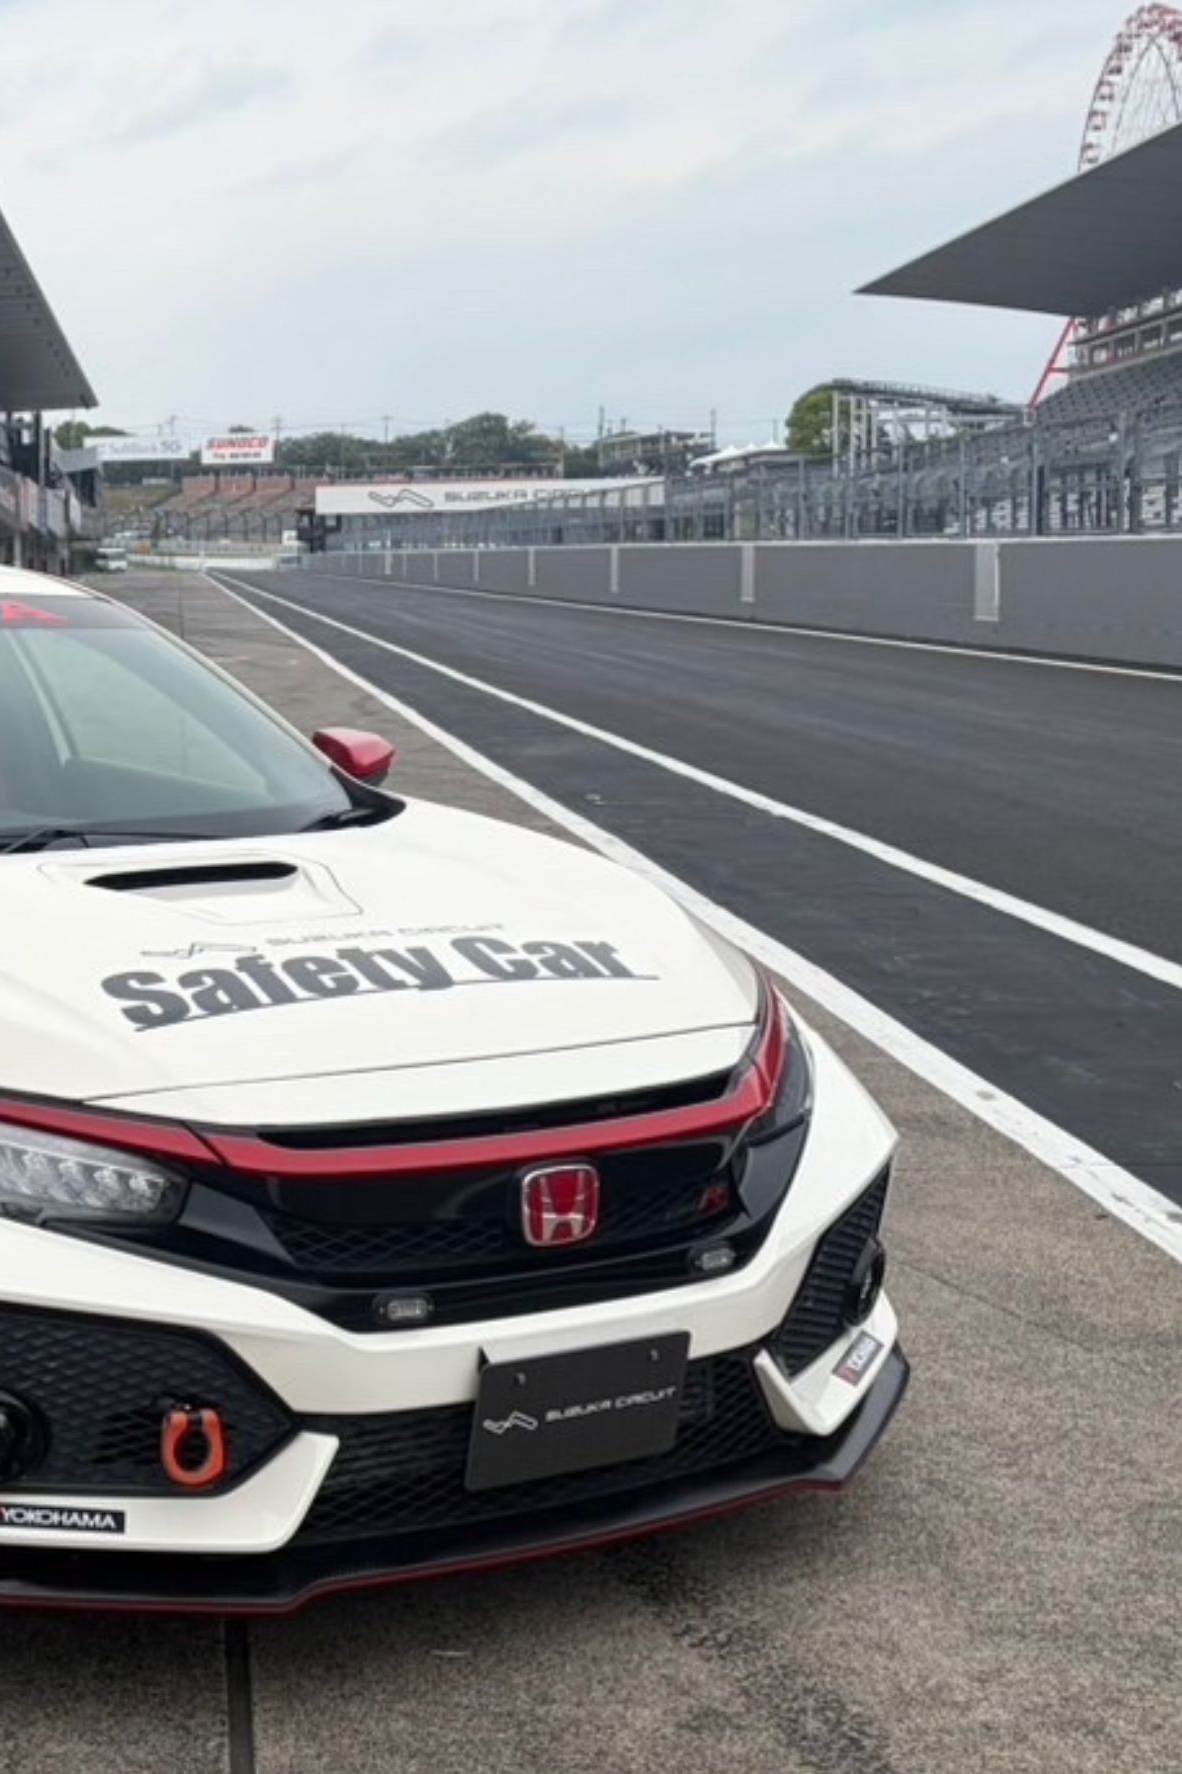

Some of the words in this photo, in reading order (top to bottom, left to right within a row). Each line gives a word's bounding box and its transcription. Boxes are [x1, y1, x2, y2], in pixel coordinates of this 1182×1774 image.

[101, 944, 455, 1028] Safety
[449, 935, 636, 980] Car
[614, 1385, 677, 1409] CIRCUIT
[0, 1506, 117, 1529] YOKOHAMA
